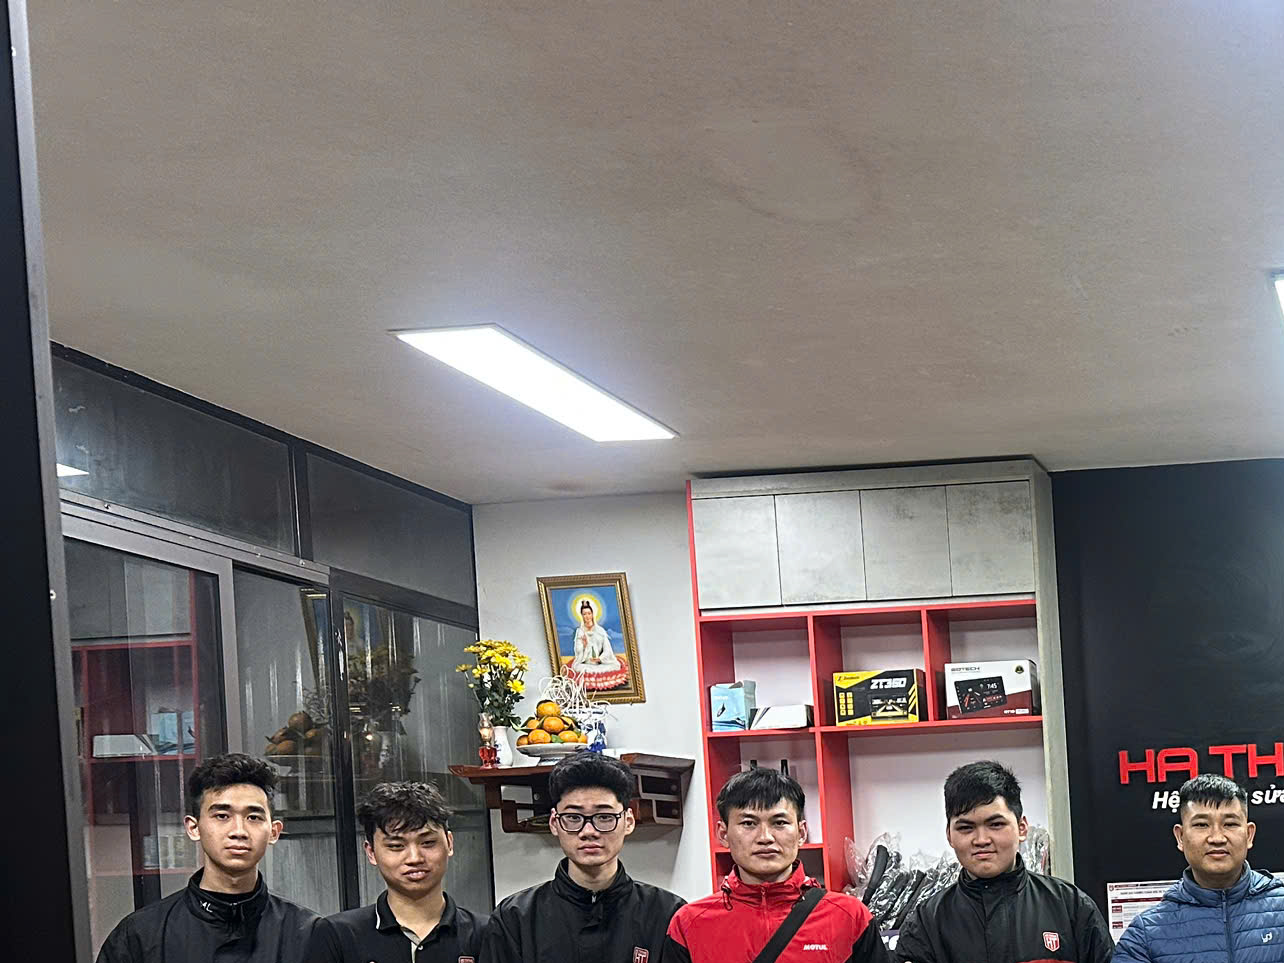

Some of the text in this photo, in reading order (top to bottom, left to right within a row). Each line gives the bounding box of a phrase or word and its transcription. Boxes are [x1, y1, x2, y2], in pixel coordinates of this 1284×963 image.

[1118, 748, 1199, 785] HA
[1152, 790, 1181, 815] Hệ
[1045, 936, 1058, 950] HT
